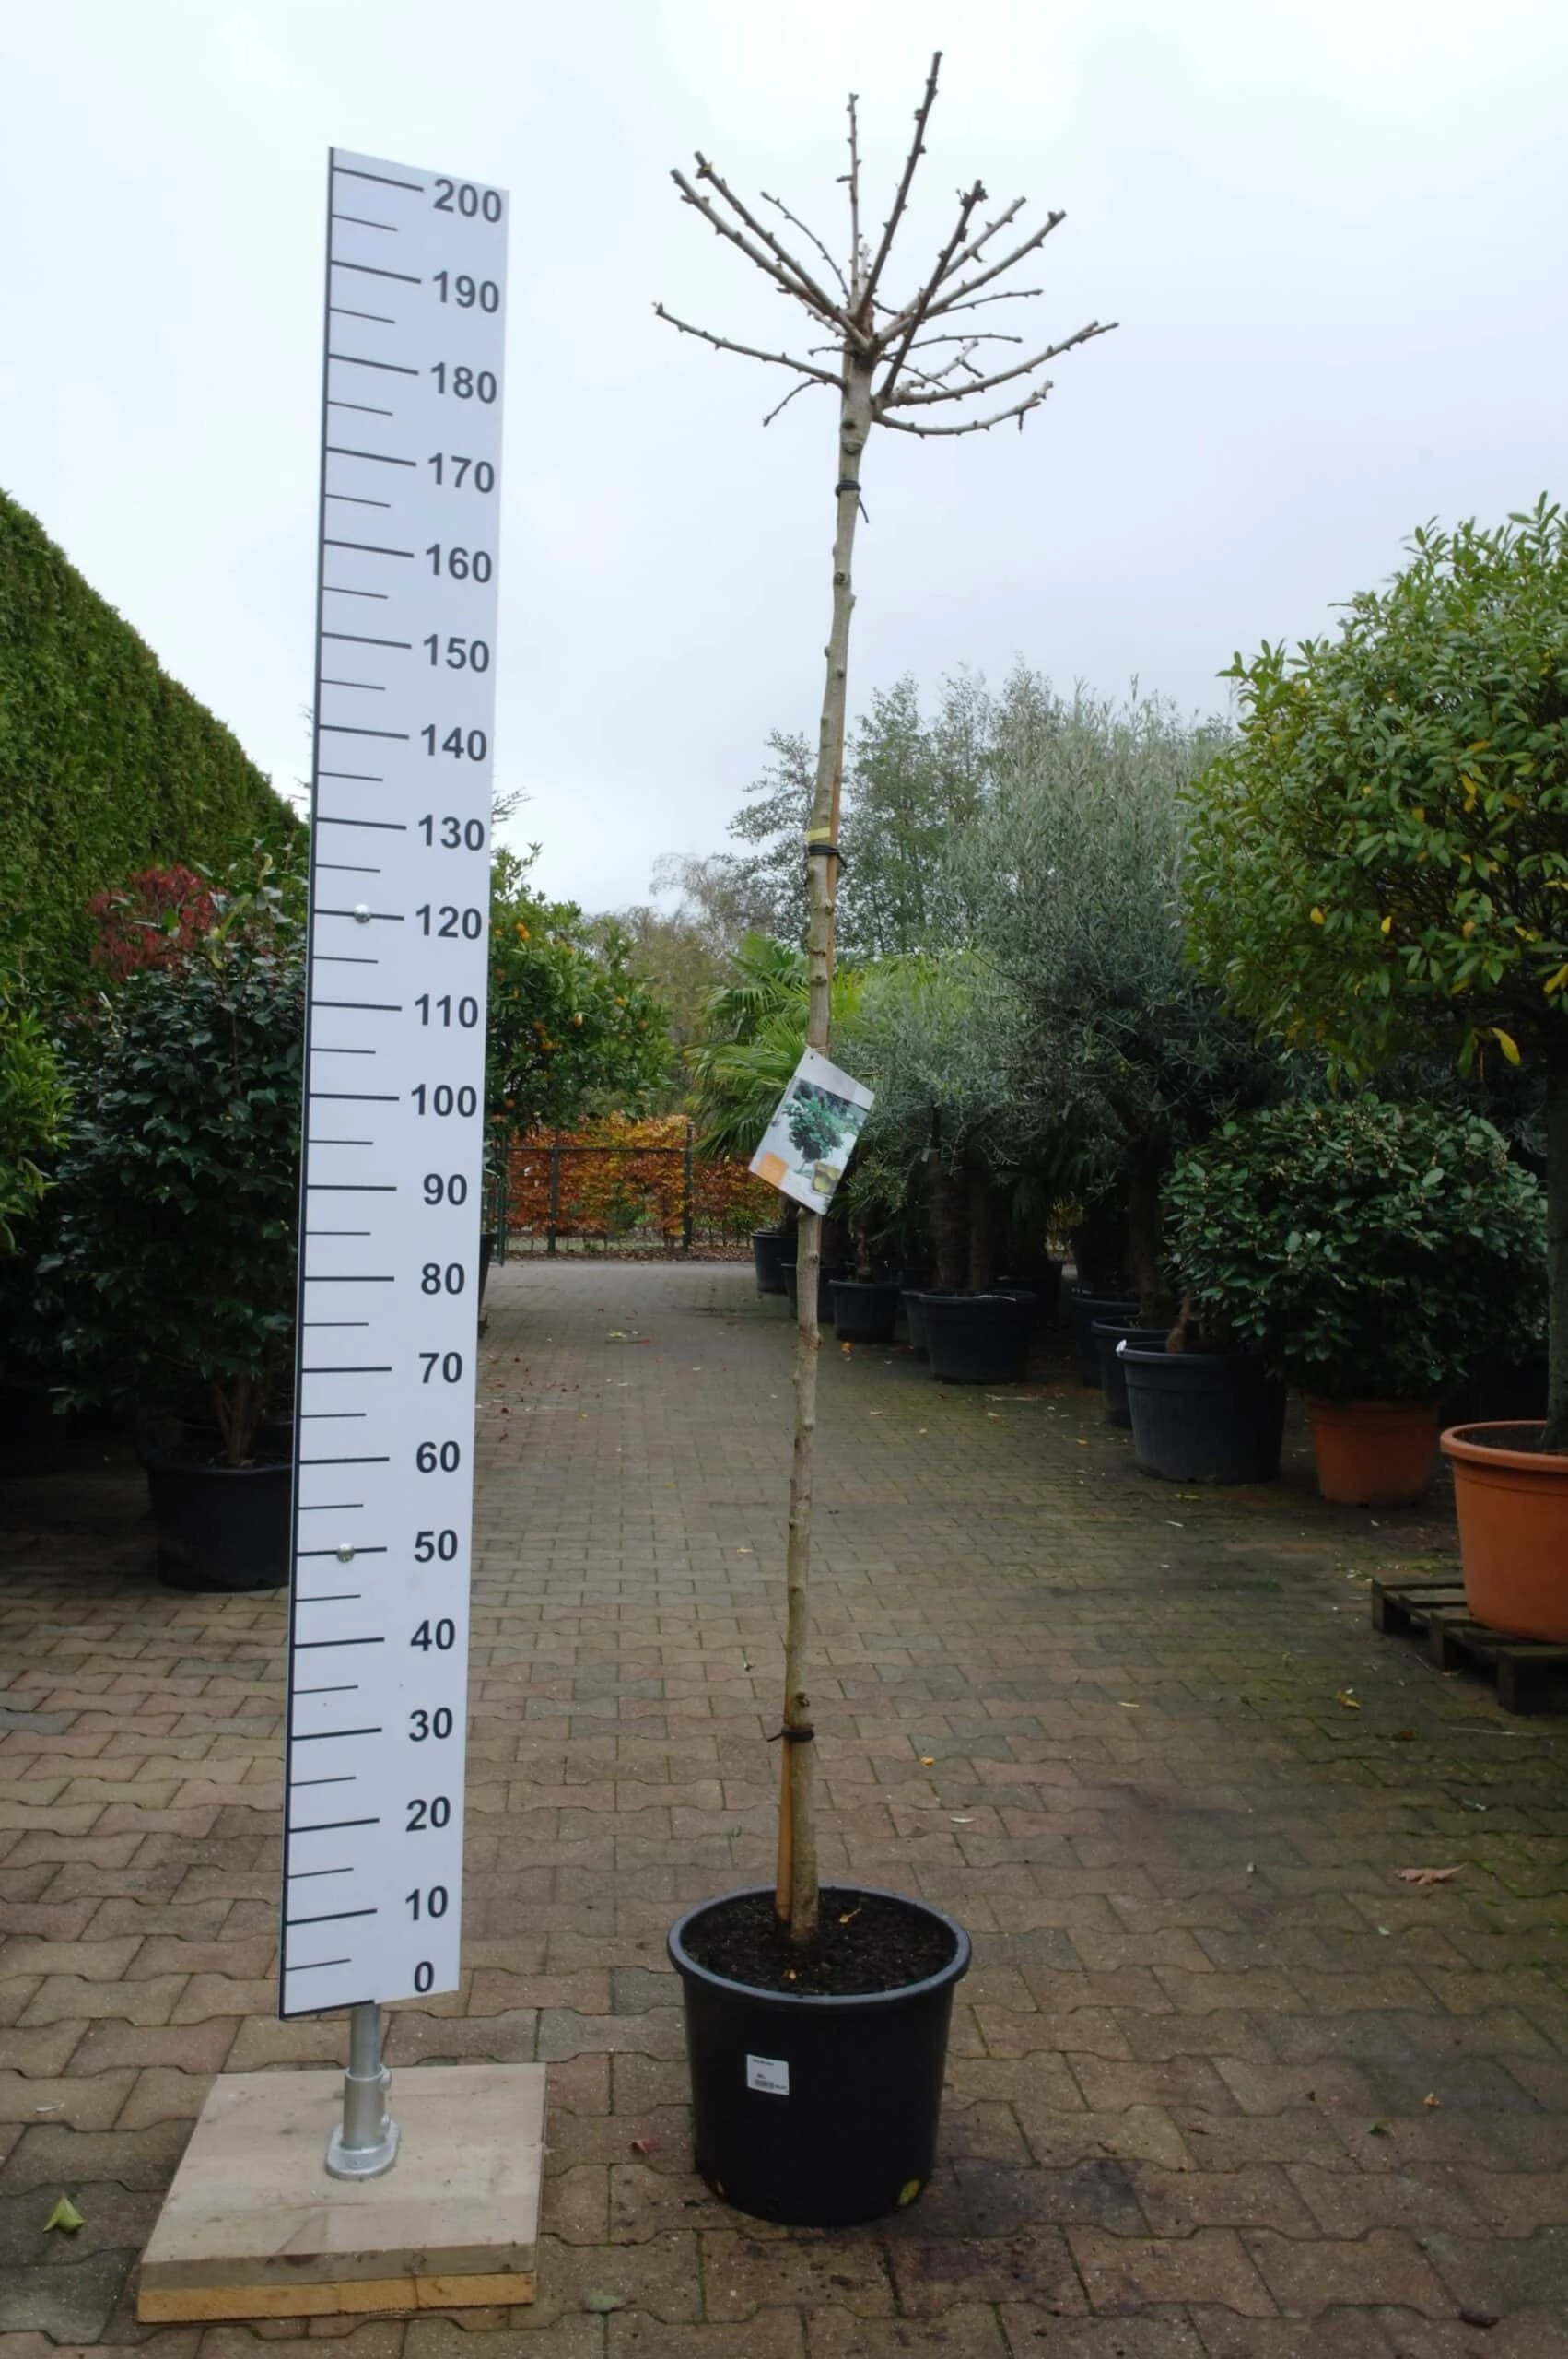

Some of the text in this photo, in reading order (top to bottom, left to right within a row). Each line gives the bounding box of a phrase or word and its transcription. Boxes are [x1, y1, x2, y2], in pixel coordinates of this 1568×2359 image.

[433, 178, 502, 223] 200
[433, 270, 499, 313] 190
[431, 361, 497, 404] 180
[428, 452, 495, 494] 170
[426, 543, 492, 583] 160
[423, 633, 489, 673] 150
[421, 723, 487, 762] 140
[418, 814, 485, 851] 130
[415, 904, 483, 940] 120
[415, 993, 479, 1028] 110
[411, 1083, 477, 1118] 100
[423, 1173, 468, 1206] 90
[420, 1262, 465, 1296] 80
[418, 1351, 463, 1384] 70
[415, 1440, 461, 1474] 60
[413, 1529, 459, 1564] 50
[409, 1618, 456, 1652] 40
[408, 1707, 453, 1743] 30
[404, 1795, 451, 1833] 20
[404, 1884, 449, 1922] 10
[413, 1960, 435, 1994] 0
